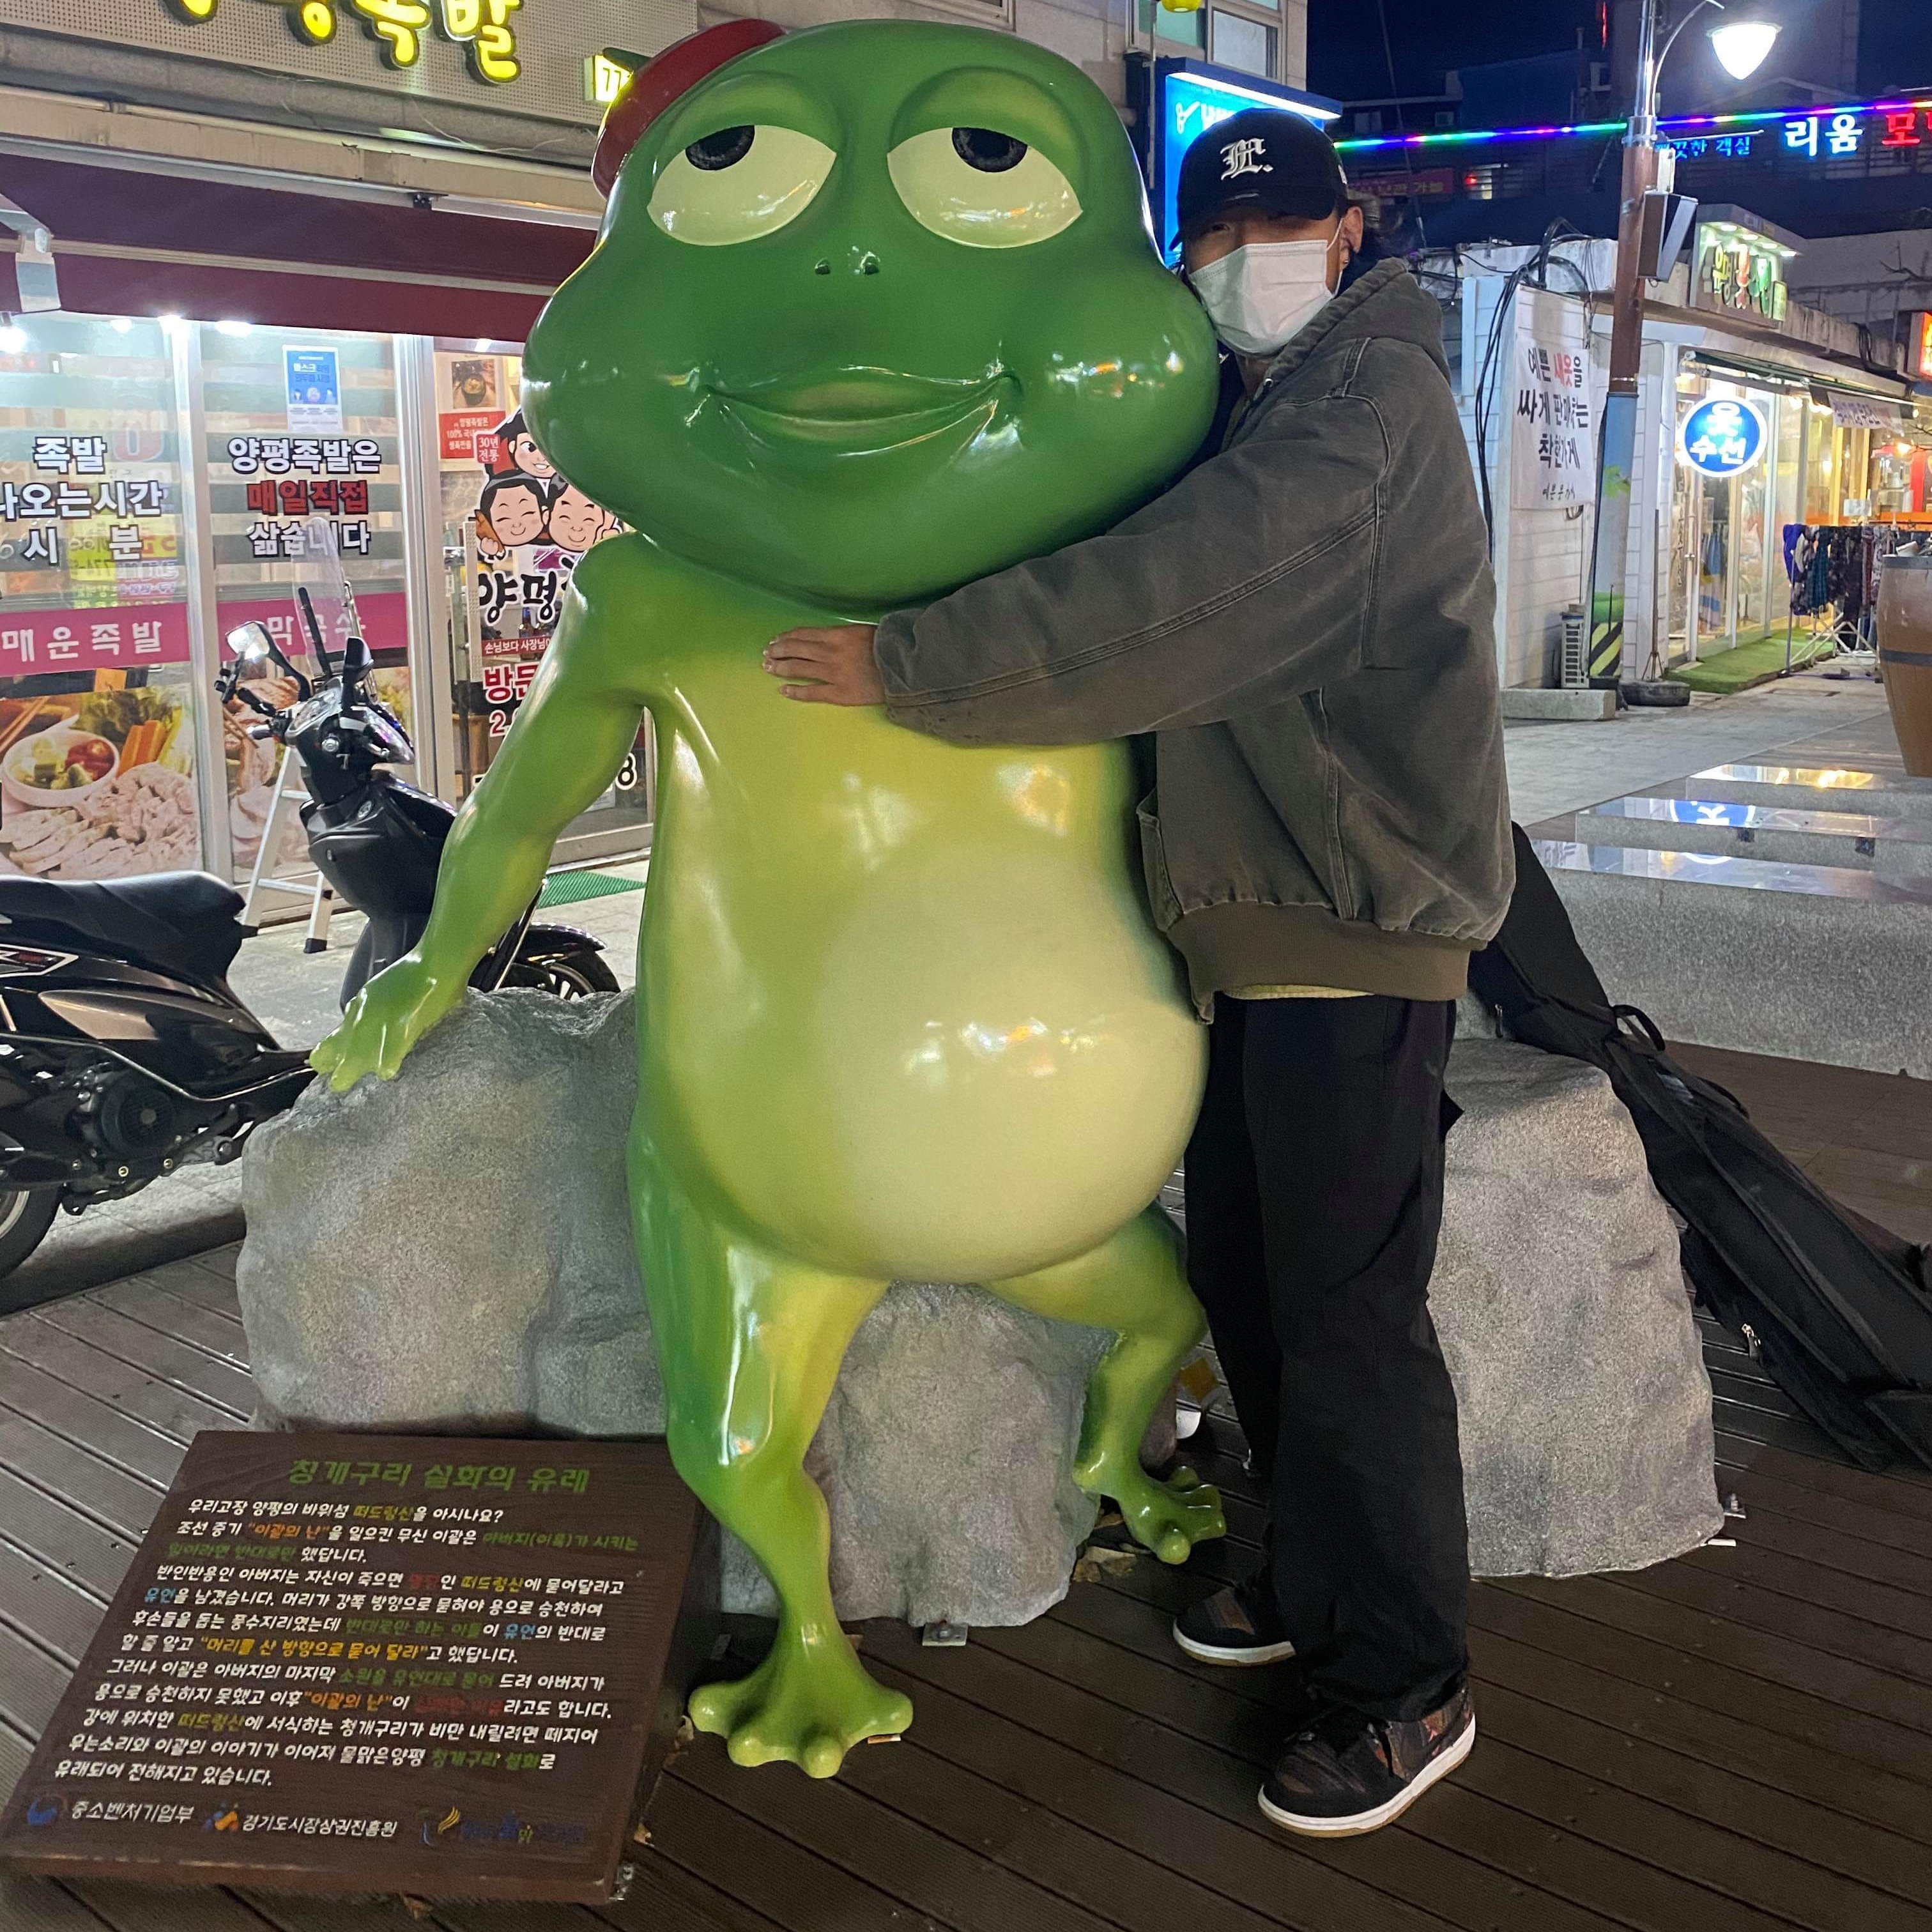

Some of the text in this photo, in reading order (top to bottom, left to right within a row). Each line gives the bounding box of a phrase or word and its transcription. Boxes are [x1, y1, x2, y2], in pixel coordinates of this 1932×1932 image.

[1715, 135, 1751, 157] 객실
[1784, 110, 1932, 157] 리움 모
[1528, 347, 1583, 388] 예쁜 새옷을
[1517, 388, 1589, 429] 싸게 판매하는
[32, 436, 107, 475] 족발
[228, 437, 382, 474] 양평족발은
[479, 436, 499, 449] 30년
[479, 449, 500, 462] 전통
[1689, 436, 1747, 464] 수선
[247, 480, 369, 516] 매일직접
[23, 526, 61, 565] 시
[109, 525, 143, 560] 분
[249, 521, 372, 558] 삶습니다
[1, 620, 162, 662] 매운족발
[289, 1459, 412, 1487] 청개구리
[527, 1467, 590, 1494] 유래
[188, 1499, 504, 1523] 우리고장 양평의 바위섬 떠드렁산을 아시나요?
[177, 1521, 208, 1535] 조선
[211, 1522, 243, 1537] 중기
[349, 1525, 394, 1542] 일으킨
[397, 1528, 428, 1544] 무신
[433, 1529, 477, 1545] 이괄은
[594, 1535, 640, 1551] 시키는
[301, 1546, 367, 1563] 했답니다.
[157, 1565, 234, 1583] 반인반용인
[238, 1567, 299, 1585] 아버지는
[305, 1569, 354, 1586] 자신이
[358, 1571, 404, 1588] 죽으면
[460, 1575, 541, 1593] 떠드렁산에
[546, 1577, 624, 1595] 묻어달라고
[144, 1587, 190, 1605] 유언을
[281, 1591, 331, 1607] 머리가
[337, 1593, 367, 1611] 강쪽
[371, 1595, 433, 1612] 방향으로
[436, 1597, 486, 1614] 묻혀야
[489, 1599, 535, 1616] 용으로
[539, 1600, 604, 1618] 승천하여
[132, 1609, 192, 1628] 후손들을
[195, 1612, 226, 1630] 돕는
[231, 1614, 342, 1633] 풍수지리였는데
[502, 1623, 553, 1640] 유언의
[557, 1625, 606, 1642] 반대로
[121, 1633, 139, 1652] 할
[141, 1635, 160, 1652] 줄
[162, 1635, 195, 1653] 알고
[259, 1639, 277, 1657] 산
[282, 1640, 344, 1659] 방향으로
[348, 1642, 381, 1659] 묻어
[448, 1645, 518, 1664] 했답니다.
[106, 1659, 157, 1675] 그러나
[161, 1660, 209, 1679] 이괄은
[214, 1662, 282, 1680] 아버지의
[285, 1665, 337, 1683] 마지막
[498, 1673, 532, 1690] 드려
[537, 1675, 606, 1692] 아버지가
[94, 1683, 143, 1701] 용으로
[146, 1684, 212, 1703] 승천하지
[215, 1687, 265, 1706] 못했고
[557, 1700, 612, 1719] 합니다.
[82, 1708, 118, 1726] 강에
[121, 1709, 175, 1729] 위치한
[266, 1716, 333, 1735] 서식하는
[339, 1717, 425, 1738] 청개구리가
[429, 1722, 465, 1742] 비만
[469, 1724, 540, 1743] 내릴려면
[544, 1726, 599, 1745] 떼지어
[68, 1733, 150, 1752] 우는소리와
[154, 1736, 206, 1756] 이괄의
[210, 1739, 280, 1758] 이야기가
[284, 1742, 337, 1761] 이어져
[54, 1758, 273, 1787] 유래되어 전해지고 있습니다.
[71, 1800, 398, 1838] 중소벤처기업부 경기도시장상권진흥원
